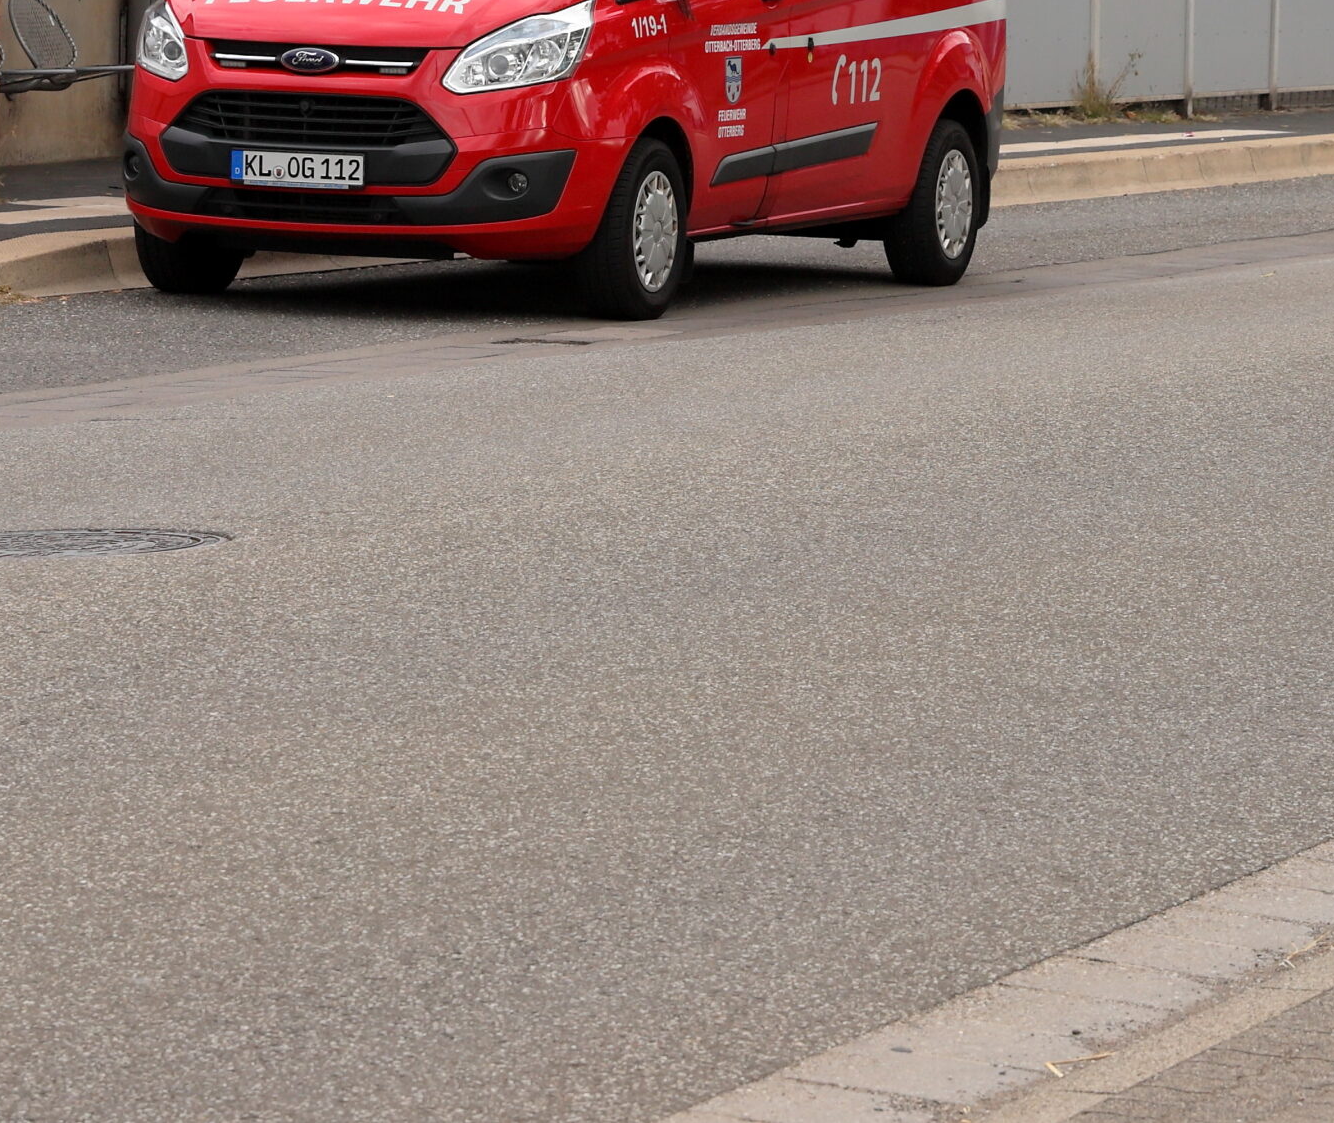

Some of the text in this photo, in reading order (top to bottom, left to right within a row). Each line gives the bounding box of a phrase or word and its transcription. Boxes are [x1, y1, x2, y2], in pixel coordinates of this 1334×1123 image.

[631, 14, 668, 39] 1/19-1
[704, 38, 761, 53] OTTERBACH-OTTERBERG
[292, 50, 323, 65] Ford
[849, 57, 882, 105] 112
[718, 108, 747, 121] FEUERWEHR
[717, 125, 745, 138] OTTERBERG
[245, 154, 360, 181] KL OG 112
